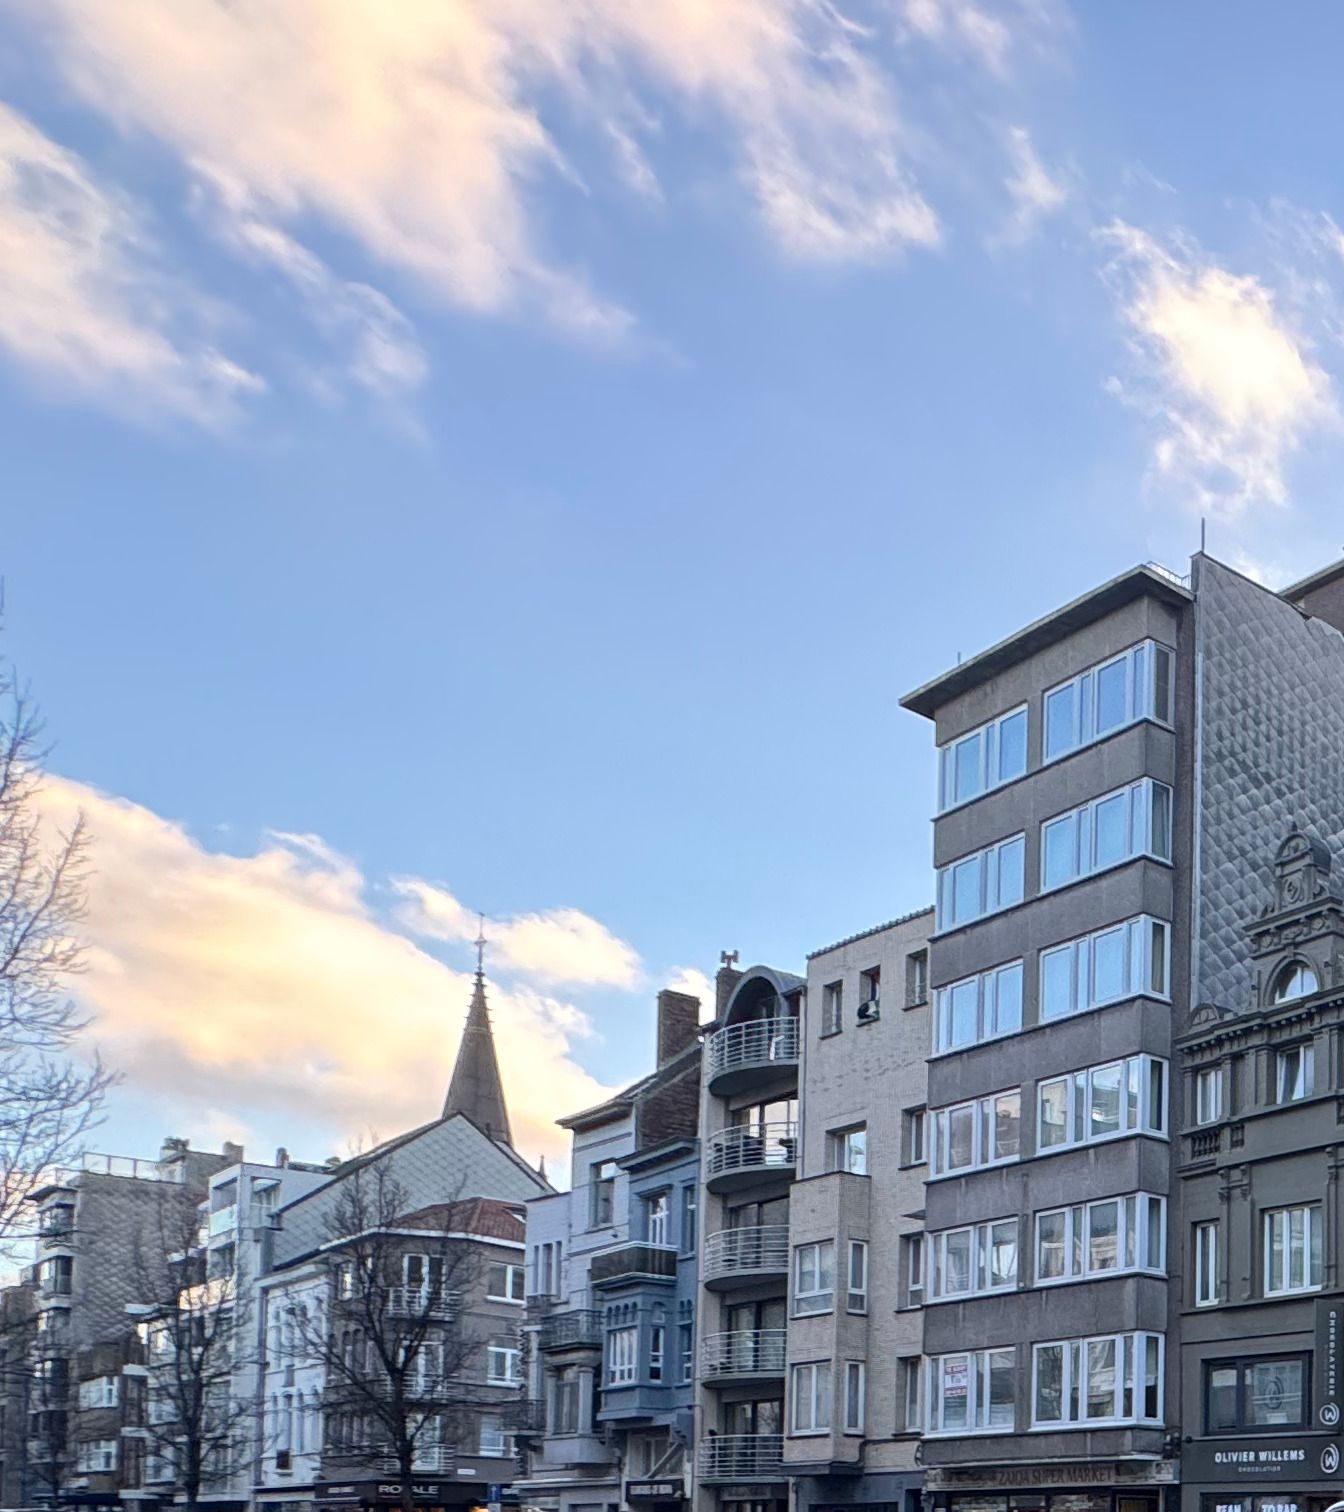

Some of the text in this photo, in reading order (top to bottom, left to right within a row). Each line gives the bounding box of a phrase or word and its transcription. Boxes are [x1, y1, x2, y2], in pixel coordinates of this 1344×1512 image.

[1214, 1449, 1305, 1463] OLIVIER WILLEMS
[1032, 1469, 1064, 1484] SUPER
[1068, 1467, 1112, 1482] MARKET
[379, 1485, 439, 1495] ROALE
